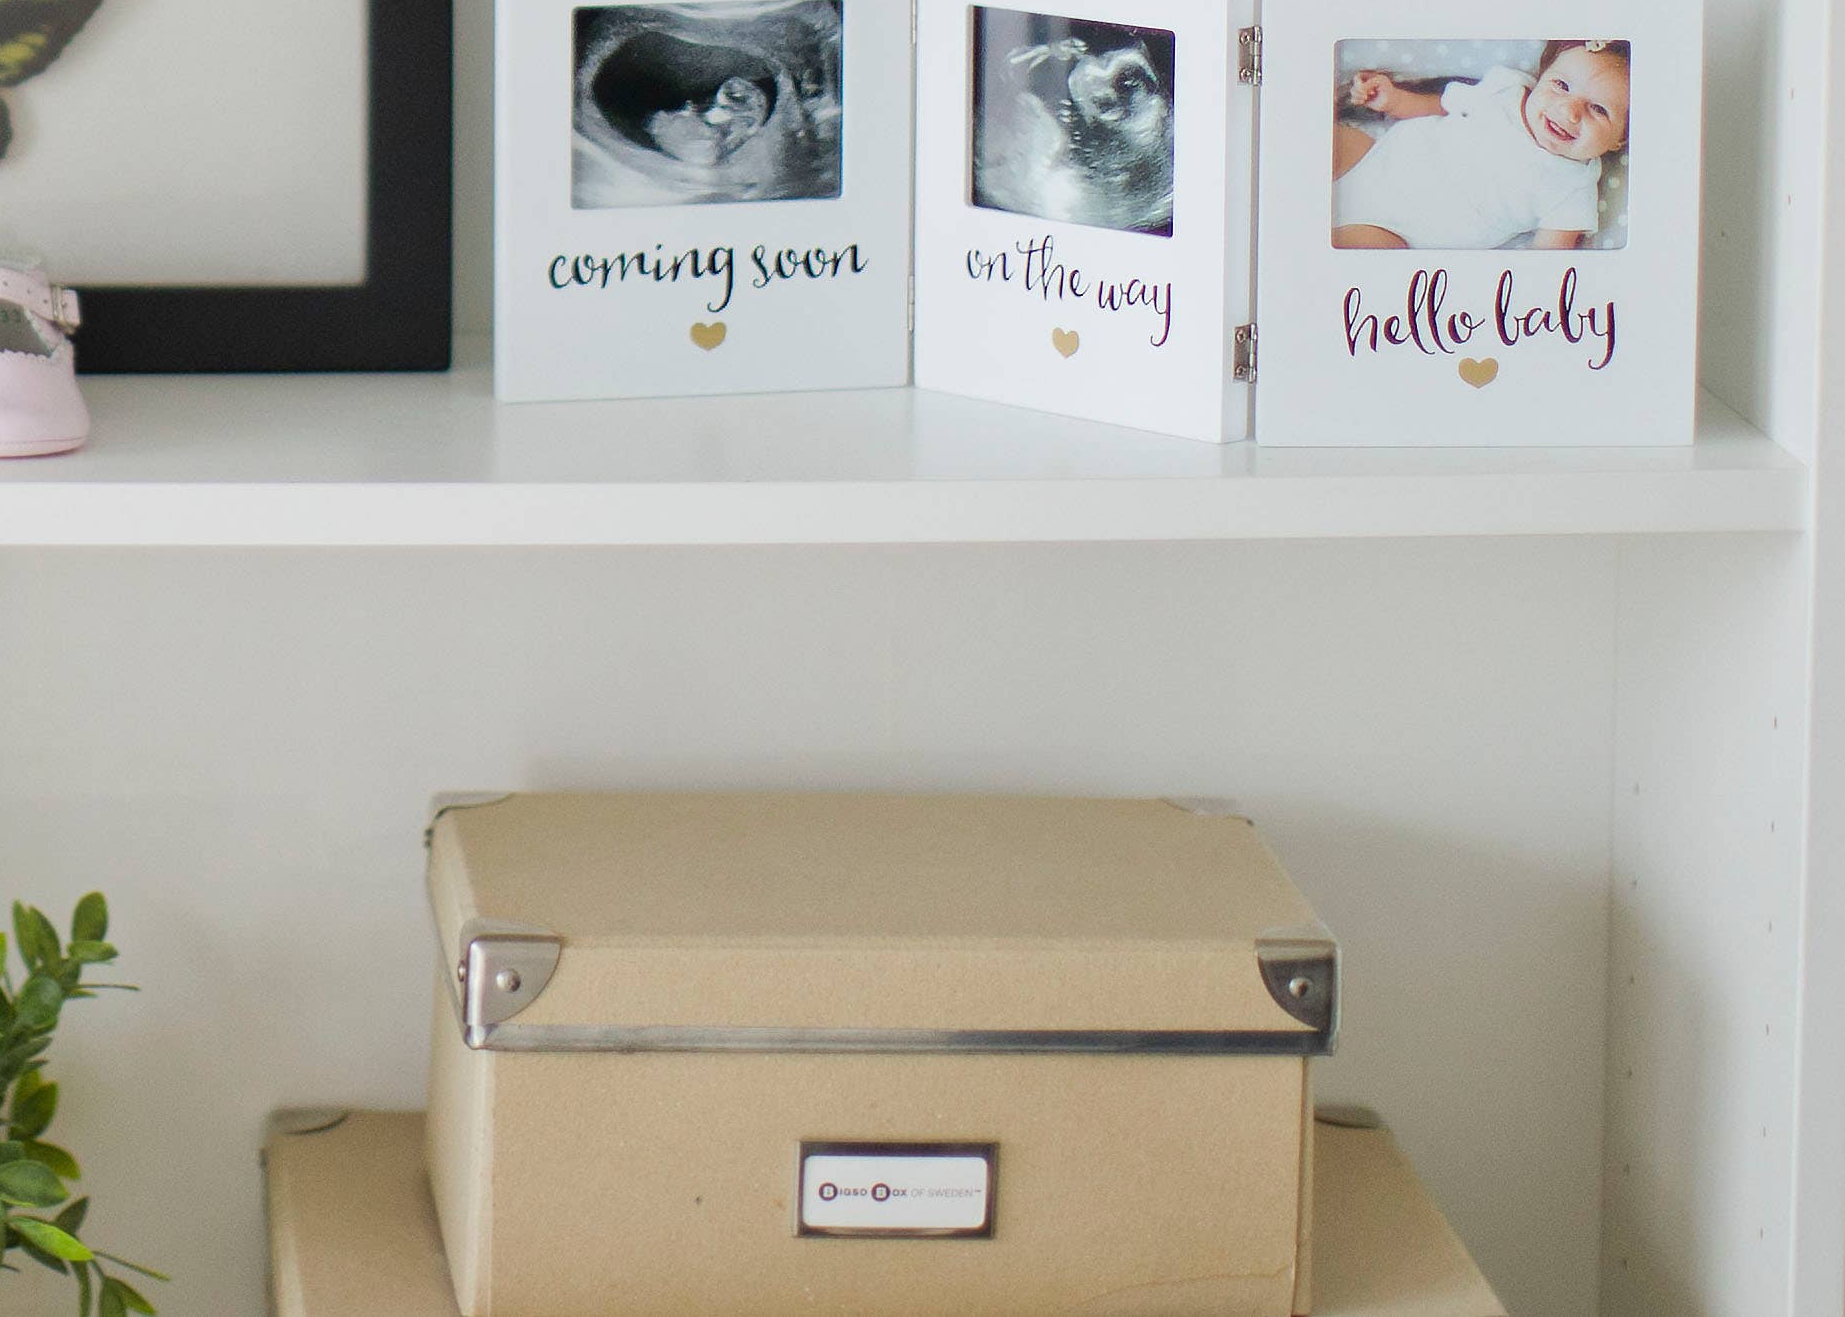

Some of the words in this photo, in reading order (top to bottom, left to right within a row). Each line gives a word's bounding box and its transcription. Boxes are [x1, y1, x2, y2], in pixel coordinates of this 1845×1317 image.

[547, 243, 734, 313] coming
[752, 243, 870, 288] soon
[966, 248, 1014, 282] on
[1016, 234, 1091, 302] the
[1098, 278, 1172, 347] way
[1343, 268, 1486, 357] hello
[1494, 266, 1616, 371] baby
[910, 1187, 925, 1199] OF
